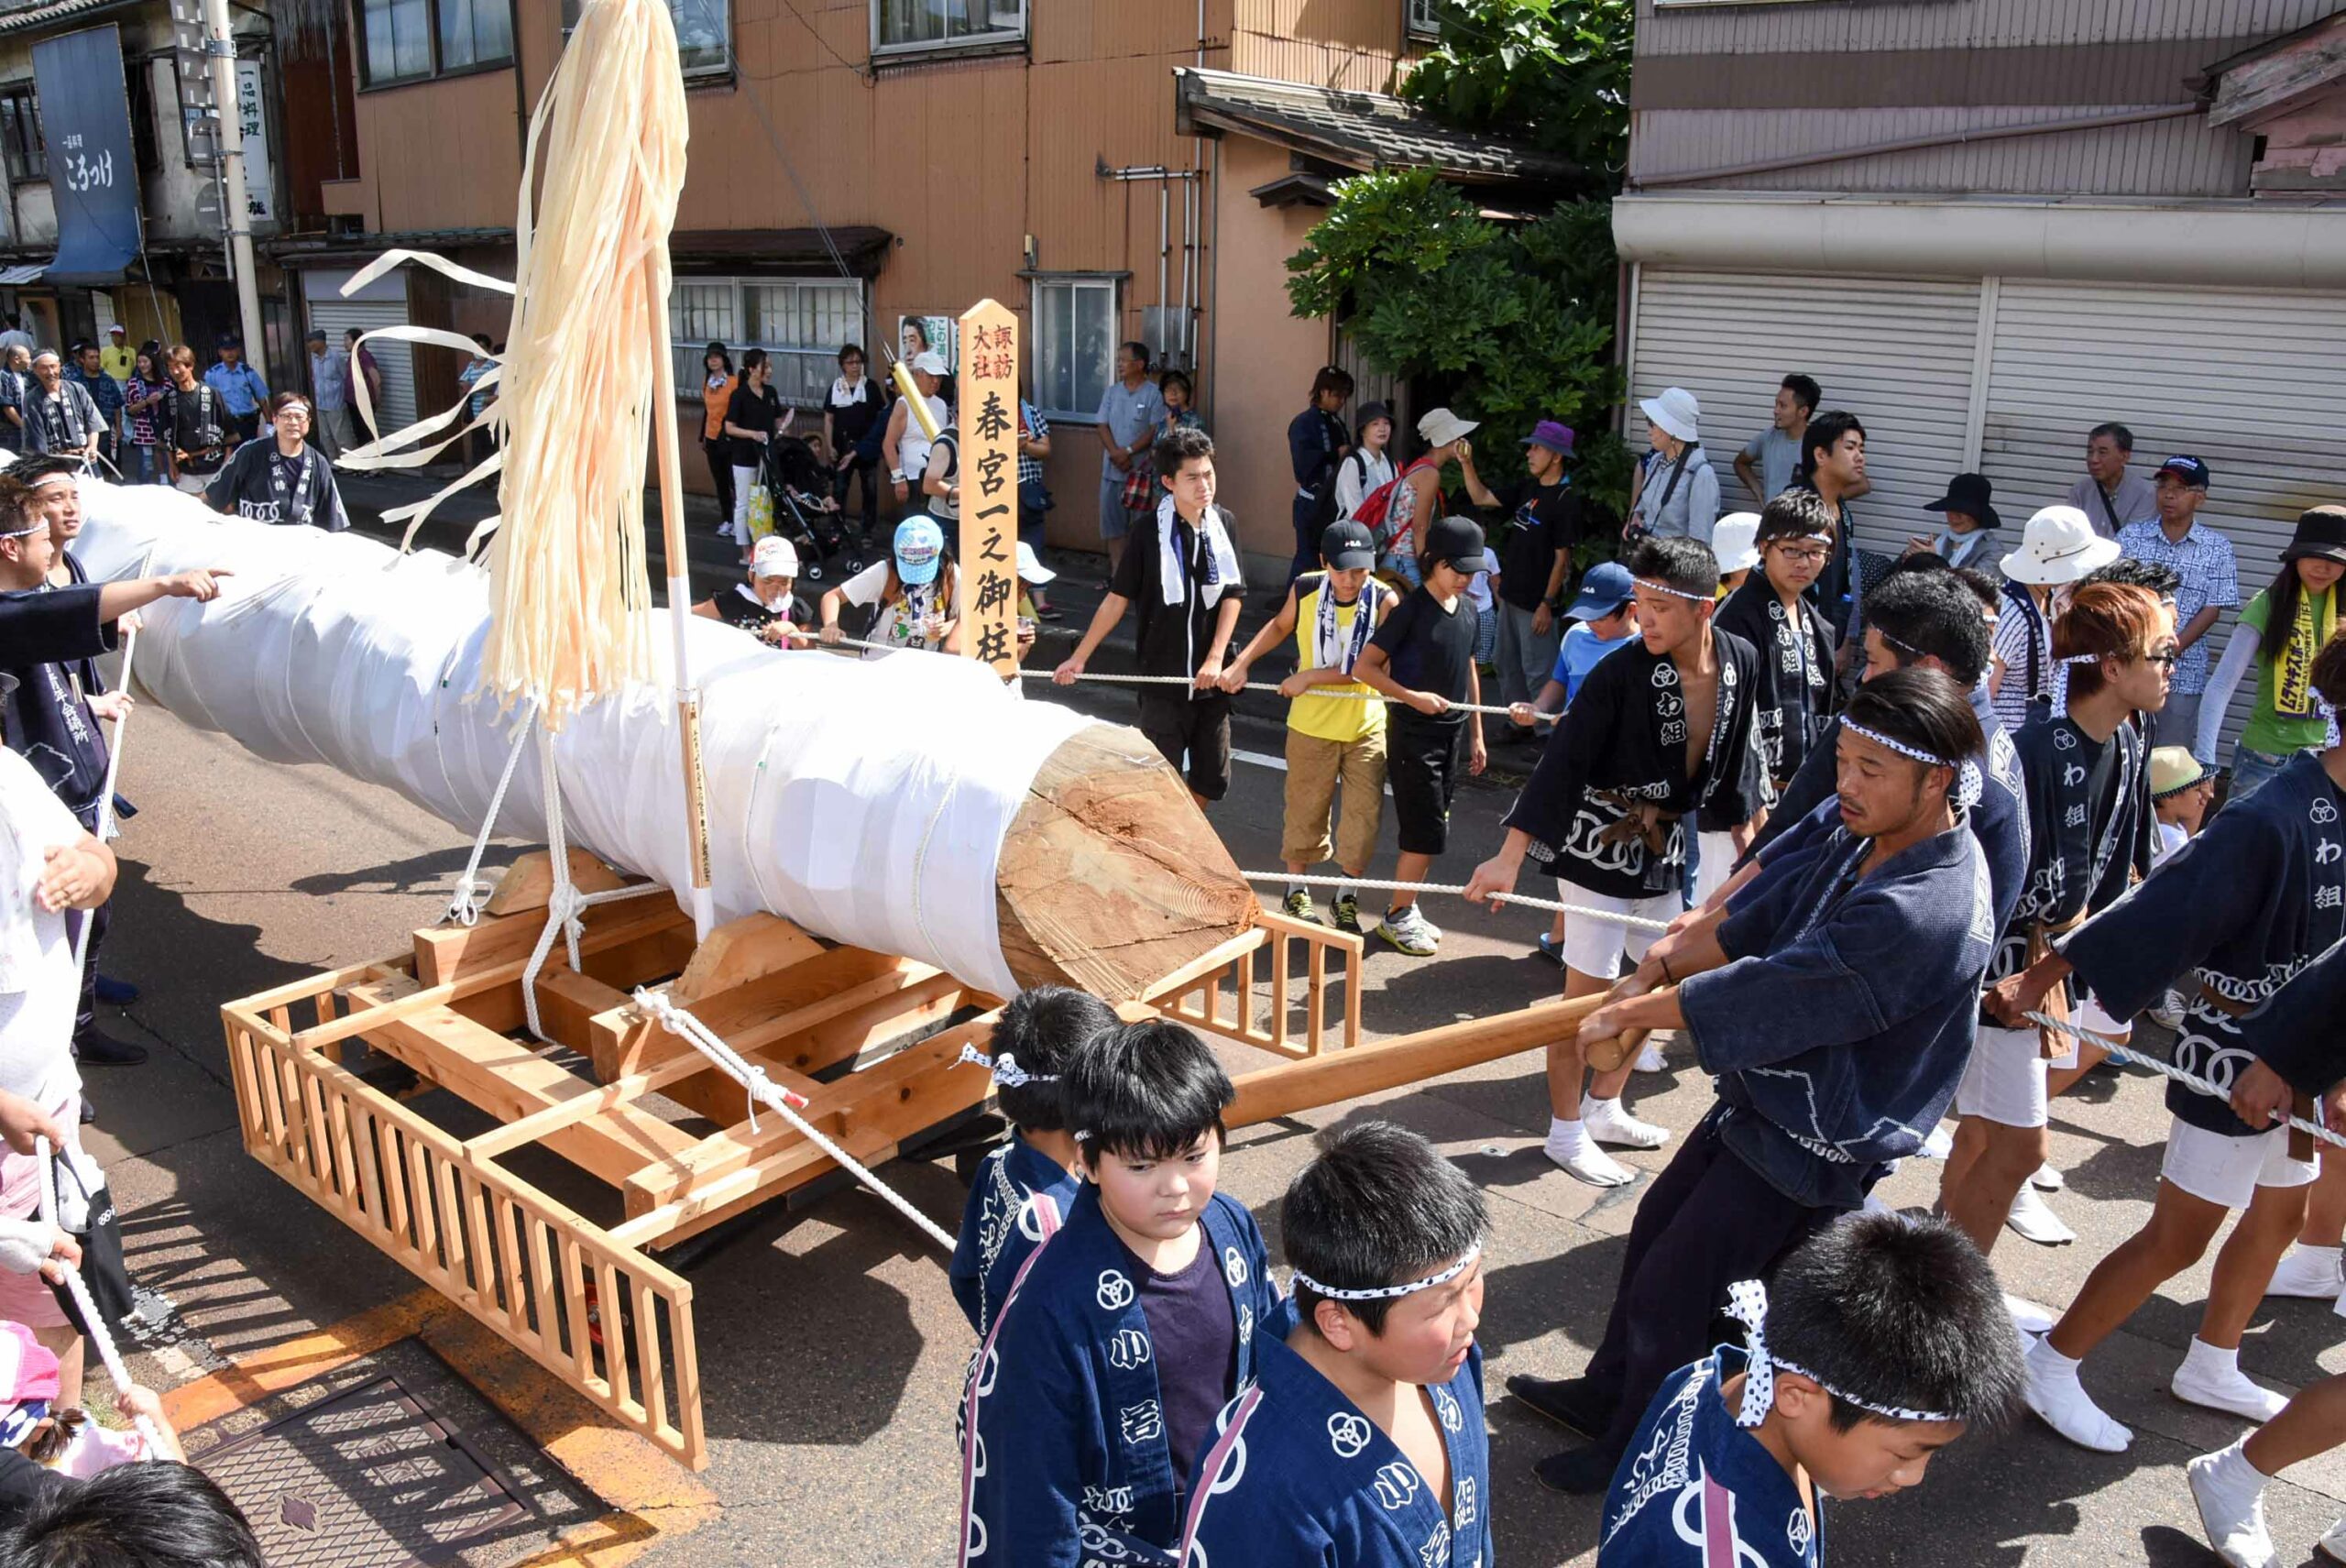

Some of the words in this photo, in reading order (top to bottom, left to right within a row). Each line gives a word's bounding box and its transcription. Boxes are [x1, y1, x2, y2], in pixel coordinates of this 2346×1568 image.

[239, 70, 260, 137] 一品料理
[971, 323, 992, 381] 大社
[993, 323, 1014, 380] 諏訪
[973, 390, 1013, 664] 春宮一之御柱
[1777, 624, 1801, 674] わ組
[2303, 629, 2313, 663] SPORTS
[1656, 691, 1686, 747] わ組
[2064, 762, 2087, 828] わ組
[2314, 837, 2343, 910] わ組
